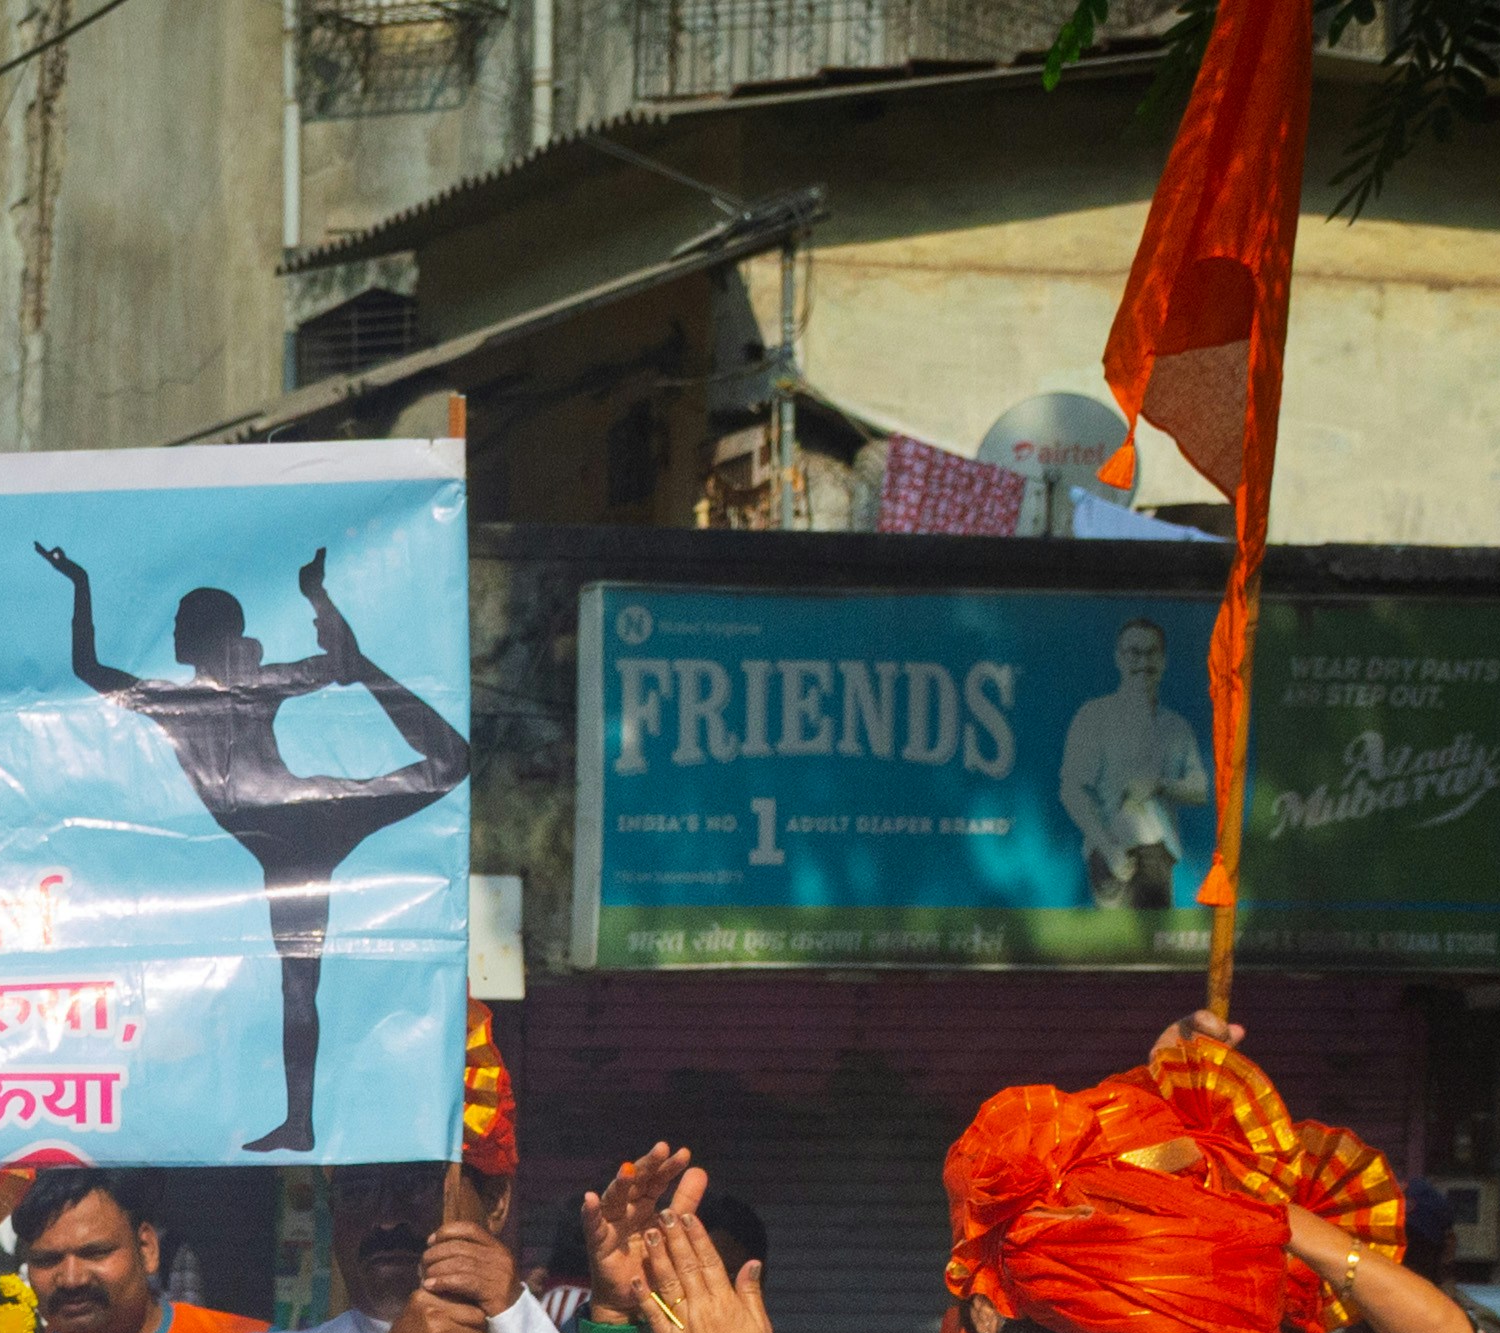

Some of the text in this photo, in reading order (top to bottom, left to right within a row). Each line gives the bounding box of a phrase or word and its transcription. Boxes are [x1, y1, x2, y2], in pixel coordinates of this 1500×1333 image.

[1290, 656, 1500, 682] WEAR DRY PANTS
[615, 658, 1016, 779] FRIENDS
[1325, 683, 1386, 708] STEP
[616, 813, 700, 833] INDIA'S
[748, 798, 785, 865] 1
[786, 815, 850, 834] ADULT
[855, 815, 933, 835] DIAPER
